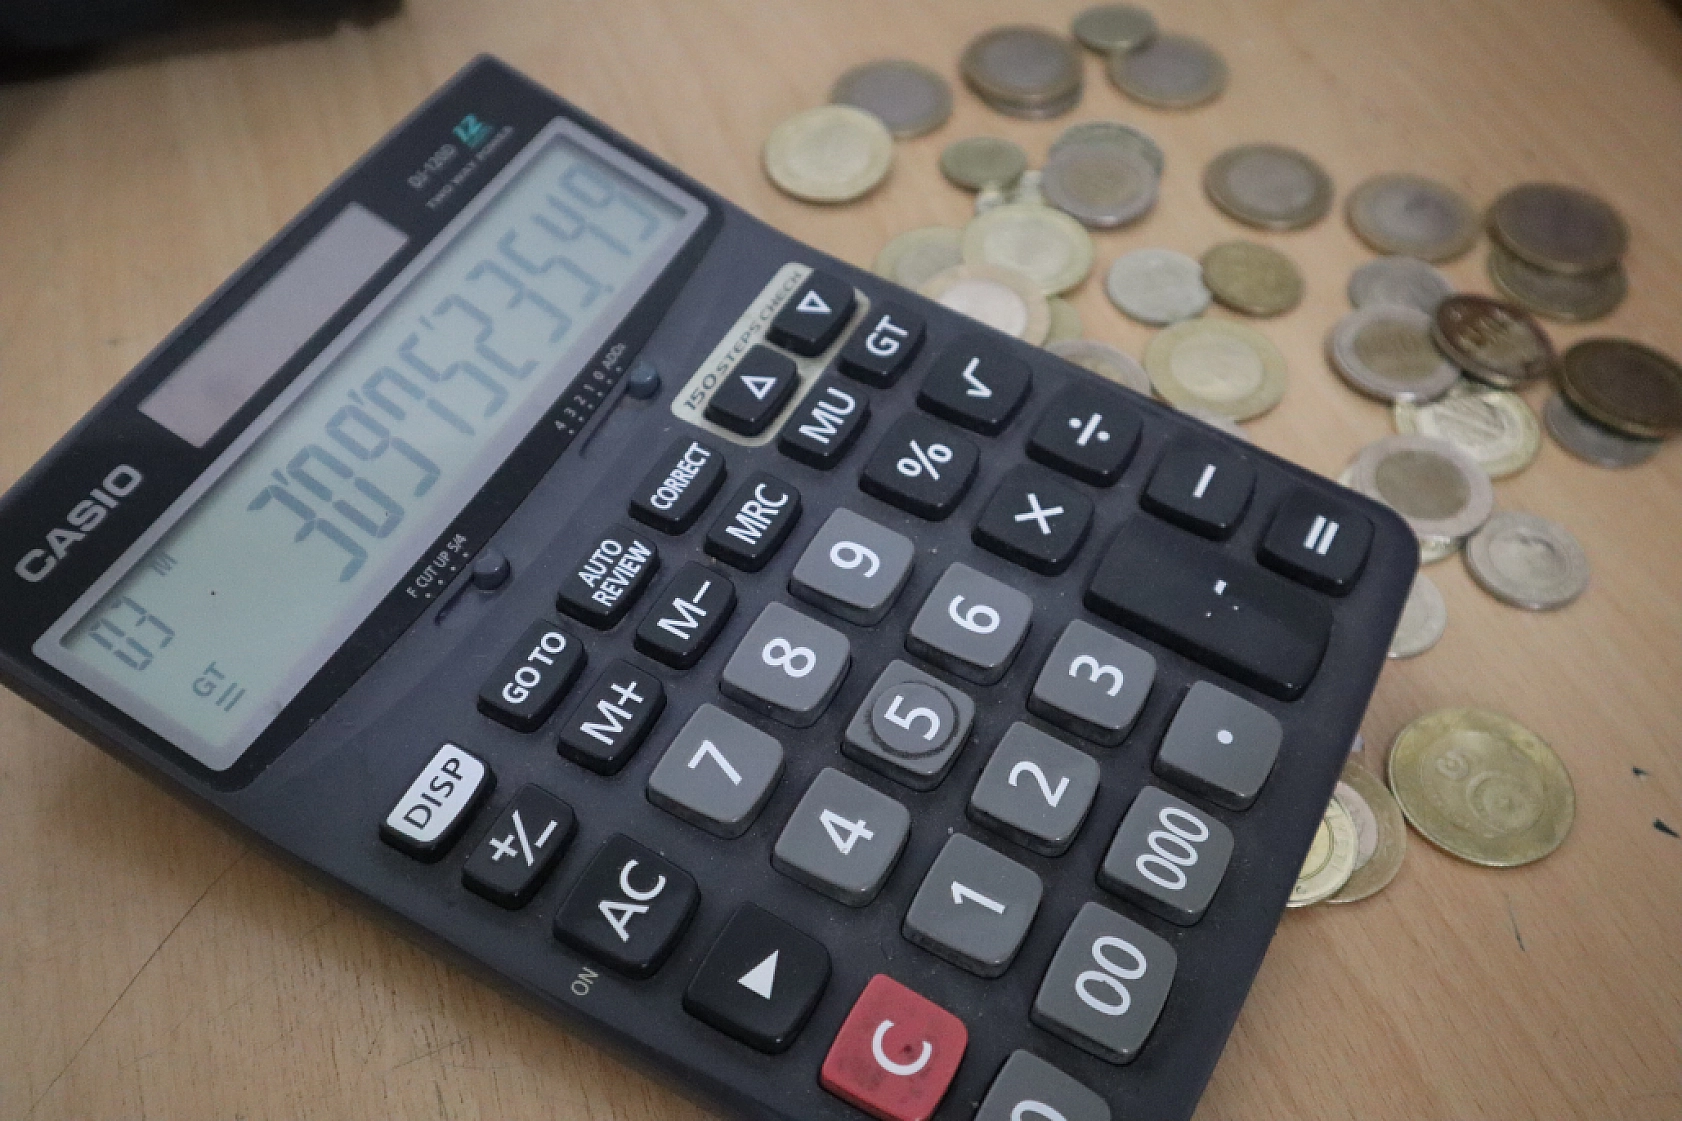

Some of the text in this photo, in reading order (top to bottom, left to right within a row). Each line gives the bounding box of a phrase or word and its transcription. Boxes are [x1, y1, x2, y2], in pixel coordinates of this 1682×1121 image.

[866, 314, 909, 357] GT
[682, 373, 718, 411] 150
[716, 320, 761, 374] STEPS
[554, 419, 567, 431] 4
[798, 386, 857, 445] MU
[649, 440, 711, 511] CORRECT
[896, 439, 953, 481] %
[14, 463, 143, 583] CASIO
[724, 482, 790, 546] MRC
[406, 533, 467, 599] F CUT UP 5/4
[577, 538, 623, 589] AUTO
[591, 539, 652, 608] REVIEW
[828, 539, 881, 579] 9
[655, 580, 712, 641] M-
[946, 593, 1002, 635] 6
[192, 661, 226, 698] GT
[501, 630, 567, 705] GO TO
[760, 637, 818, 679] 8
[1067, 653, 1125, 698] 3
[578, 680, 644, 747] M+
[882, 693, 942, 742] 5
[686, 738, 744, 788] 7
[1007, 759, 1071, 809] 2
[402, 757, 464, 830] DISP
[818, 807, 875, 857] 4
[1134, 805, 1210, 891] 000
[598, 858, 667, 943] AC
[949, 879, 1007, 916] 1
[570, 965, 600, 997] ON
[1074, 935, 1148, 1017] 00
[871, 1018, 933, 1077] C
